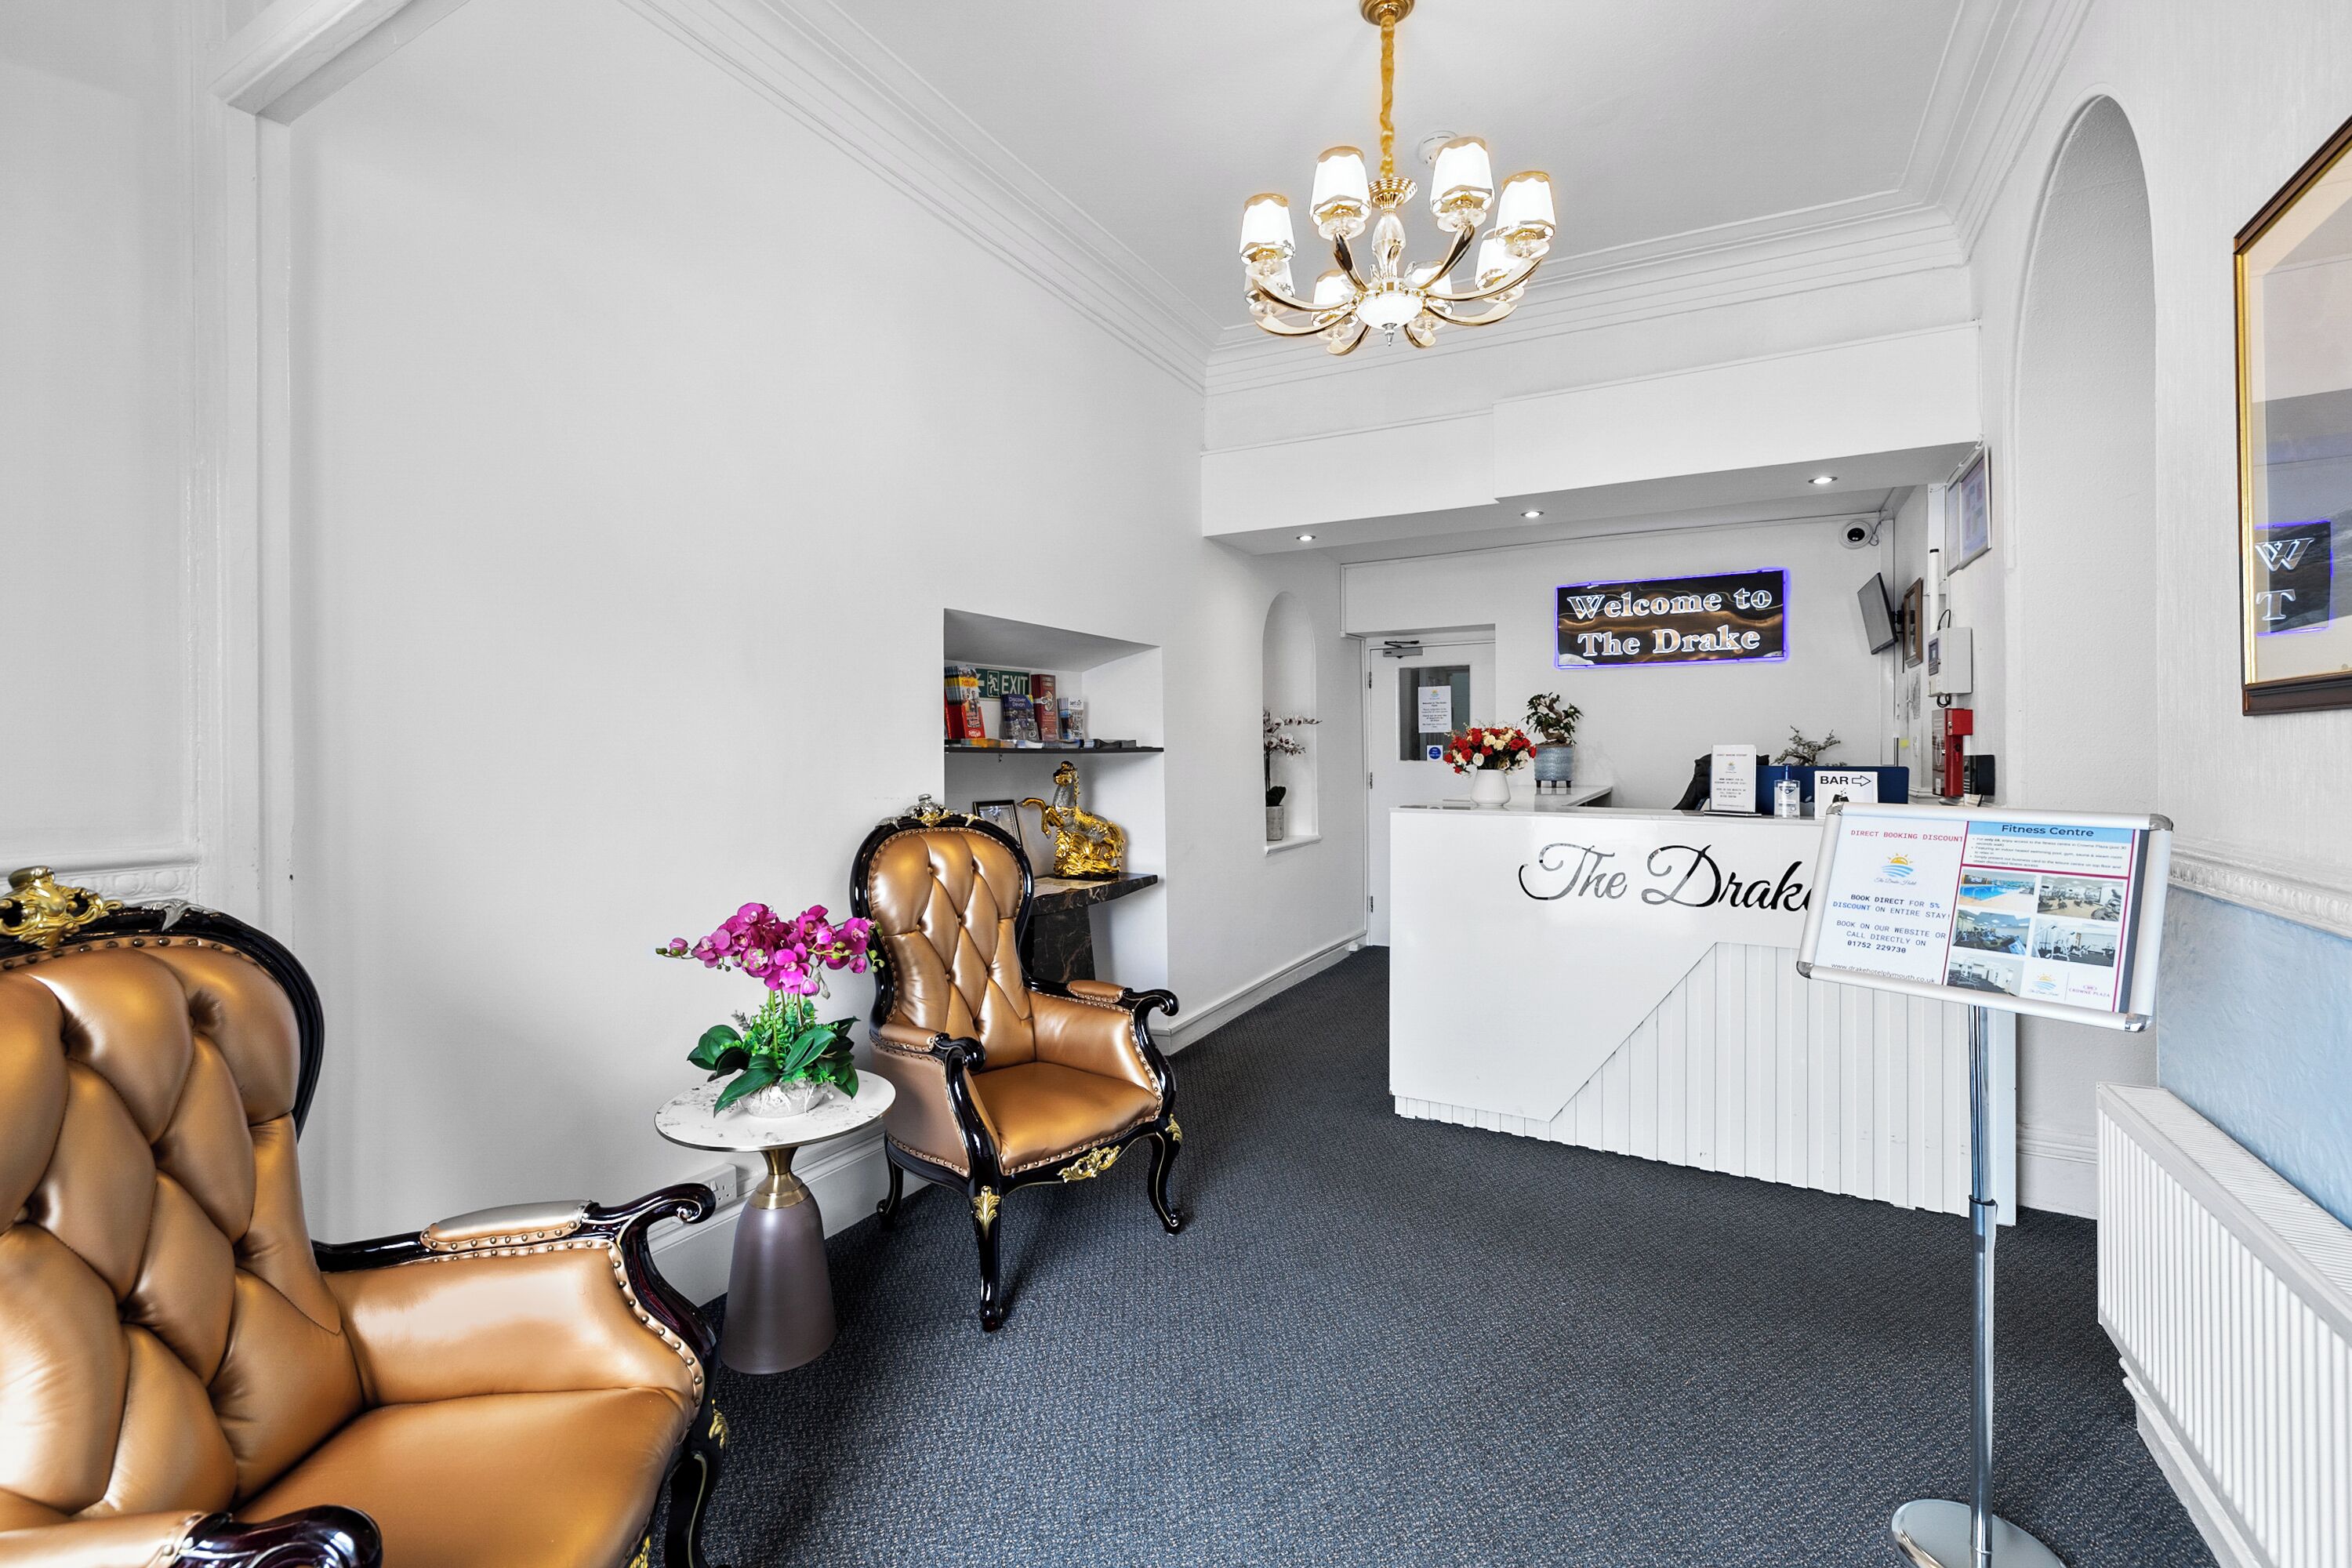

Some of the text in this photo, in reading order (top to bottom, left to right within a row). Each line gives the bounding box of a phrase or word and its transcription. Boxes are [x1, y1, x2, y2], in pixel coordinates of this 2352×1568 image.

[1566, 587, 1772, 619] Welcome to
[1577, 624, 1761, 657] The Drake
[1001, 674, 1028, 695] EXIT
[1820, 775, 1849, 785] BAR
[2002, 824, 2094, 837] Fitness Centre
[1518, 842, 1628, 901] The
[1874, 896, 1904, 905] DIRECT
[1832, 901, 1871, 910] DISCOUNT
[1889, 907, 1920, 916] ENTIRE
[1926, 911, 1951, 920] STAY!
[1836, 920, 1856, 928] BOOK
[1894, 927, 1930, 937] WEBSITE
[1847, 939, 1907, 953] 01752 229730
[1870, 933, 1911, 945] DIRECTLY
[1831, 963, 1935, 984] www.drakehotelplymouth.co.uk
